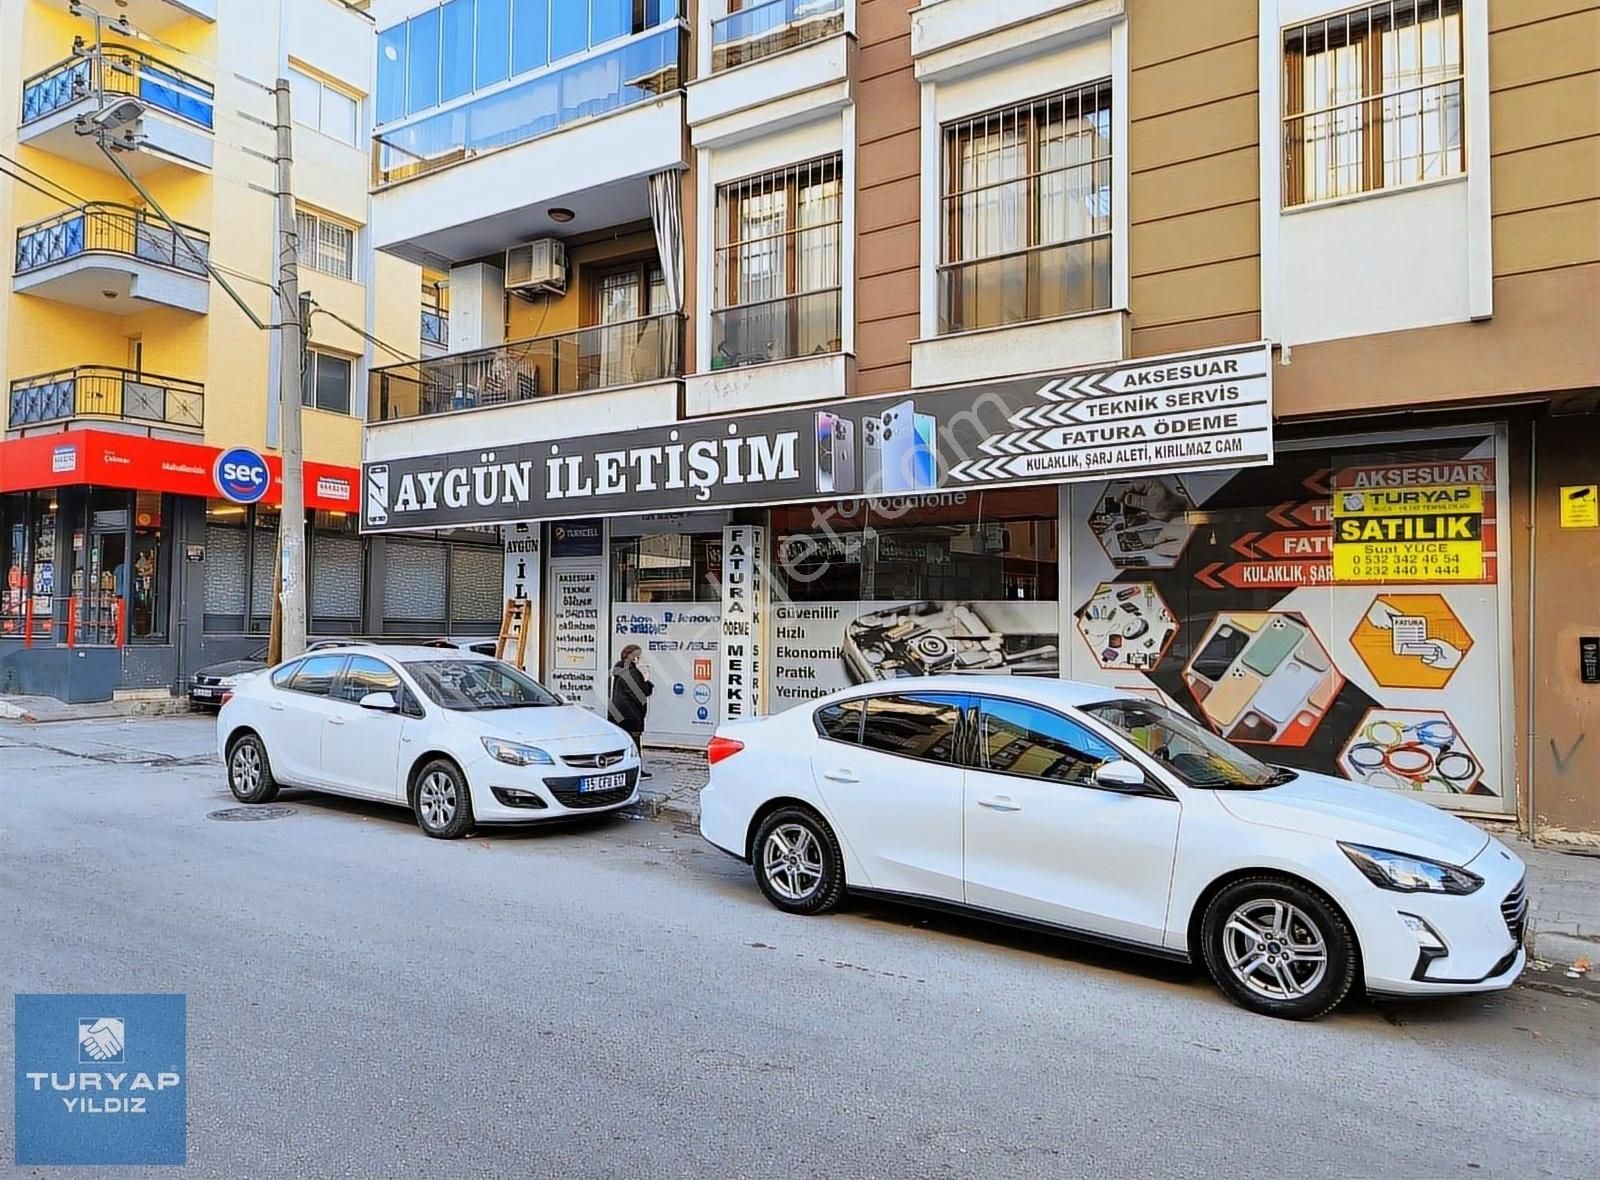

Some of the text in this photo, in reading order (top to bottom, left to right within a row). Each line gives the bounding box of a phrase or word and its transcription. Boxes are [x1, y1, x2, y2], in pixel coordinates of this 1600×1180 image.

[1123, 359, 1238, 387] AKSESUAR
[1086, 386, 1239, 418] TEKNİK SERVİS
[1062, 413, 1238, 445] FATURA ÖDEME
[1026, 438, 1242, 471] KULAKLIK, ŞARJ ALETİ, KIRILMAZ CAM
[393, 423, 800, 512] AYGÜN İLETİŞİM
[1353, 465, 1485, 488] AKSESUAR
[1370, 489, 1471, 504] TURYAP
[1341, 516, 1472, 541] SATILIK
[507, 536, 538, 553] AYGÜN
[1353, 554, 1460, 564] 0 532 342 46 54
[729, 530, 744, 613] FATURA
[1243, 565, 1306, 585] KULAKLIK,
[1353, 566, 1360, 575] 0
[1365, 566, 1388, 575] 232
[1394, 566, 1417, 575] 440
[1435, 566, 1460, 575] 444
[776, 606, 839, 619] Güvenilir
[776, 627, 804, 638] Hızlı
[776, 646, 844, 659] Ekonomik
[728, 645, 743, 720] MERKE
[776, 666, 815, 678] Pratik
